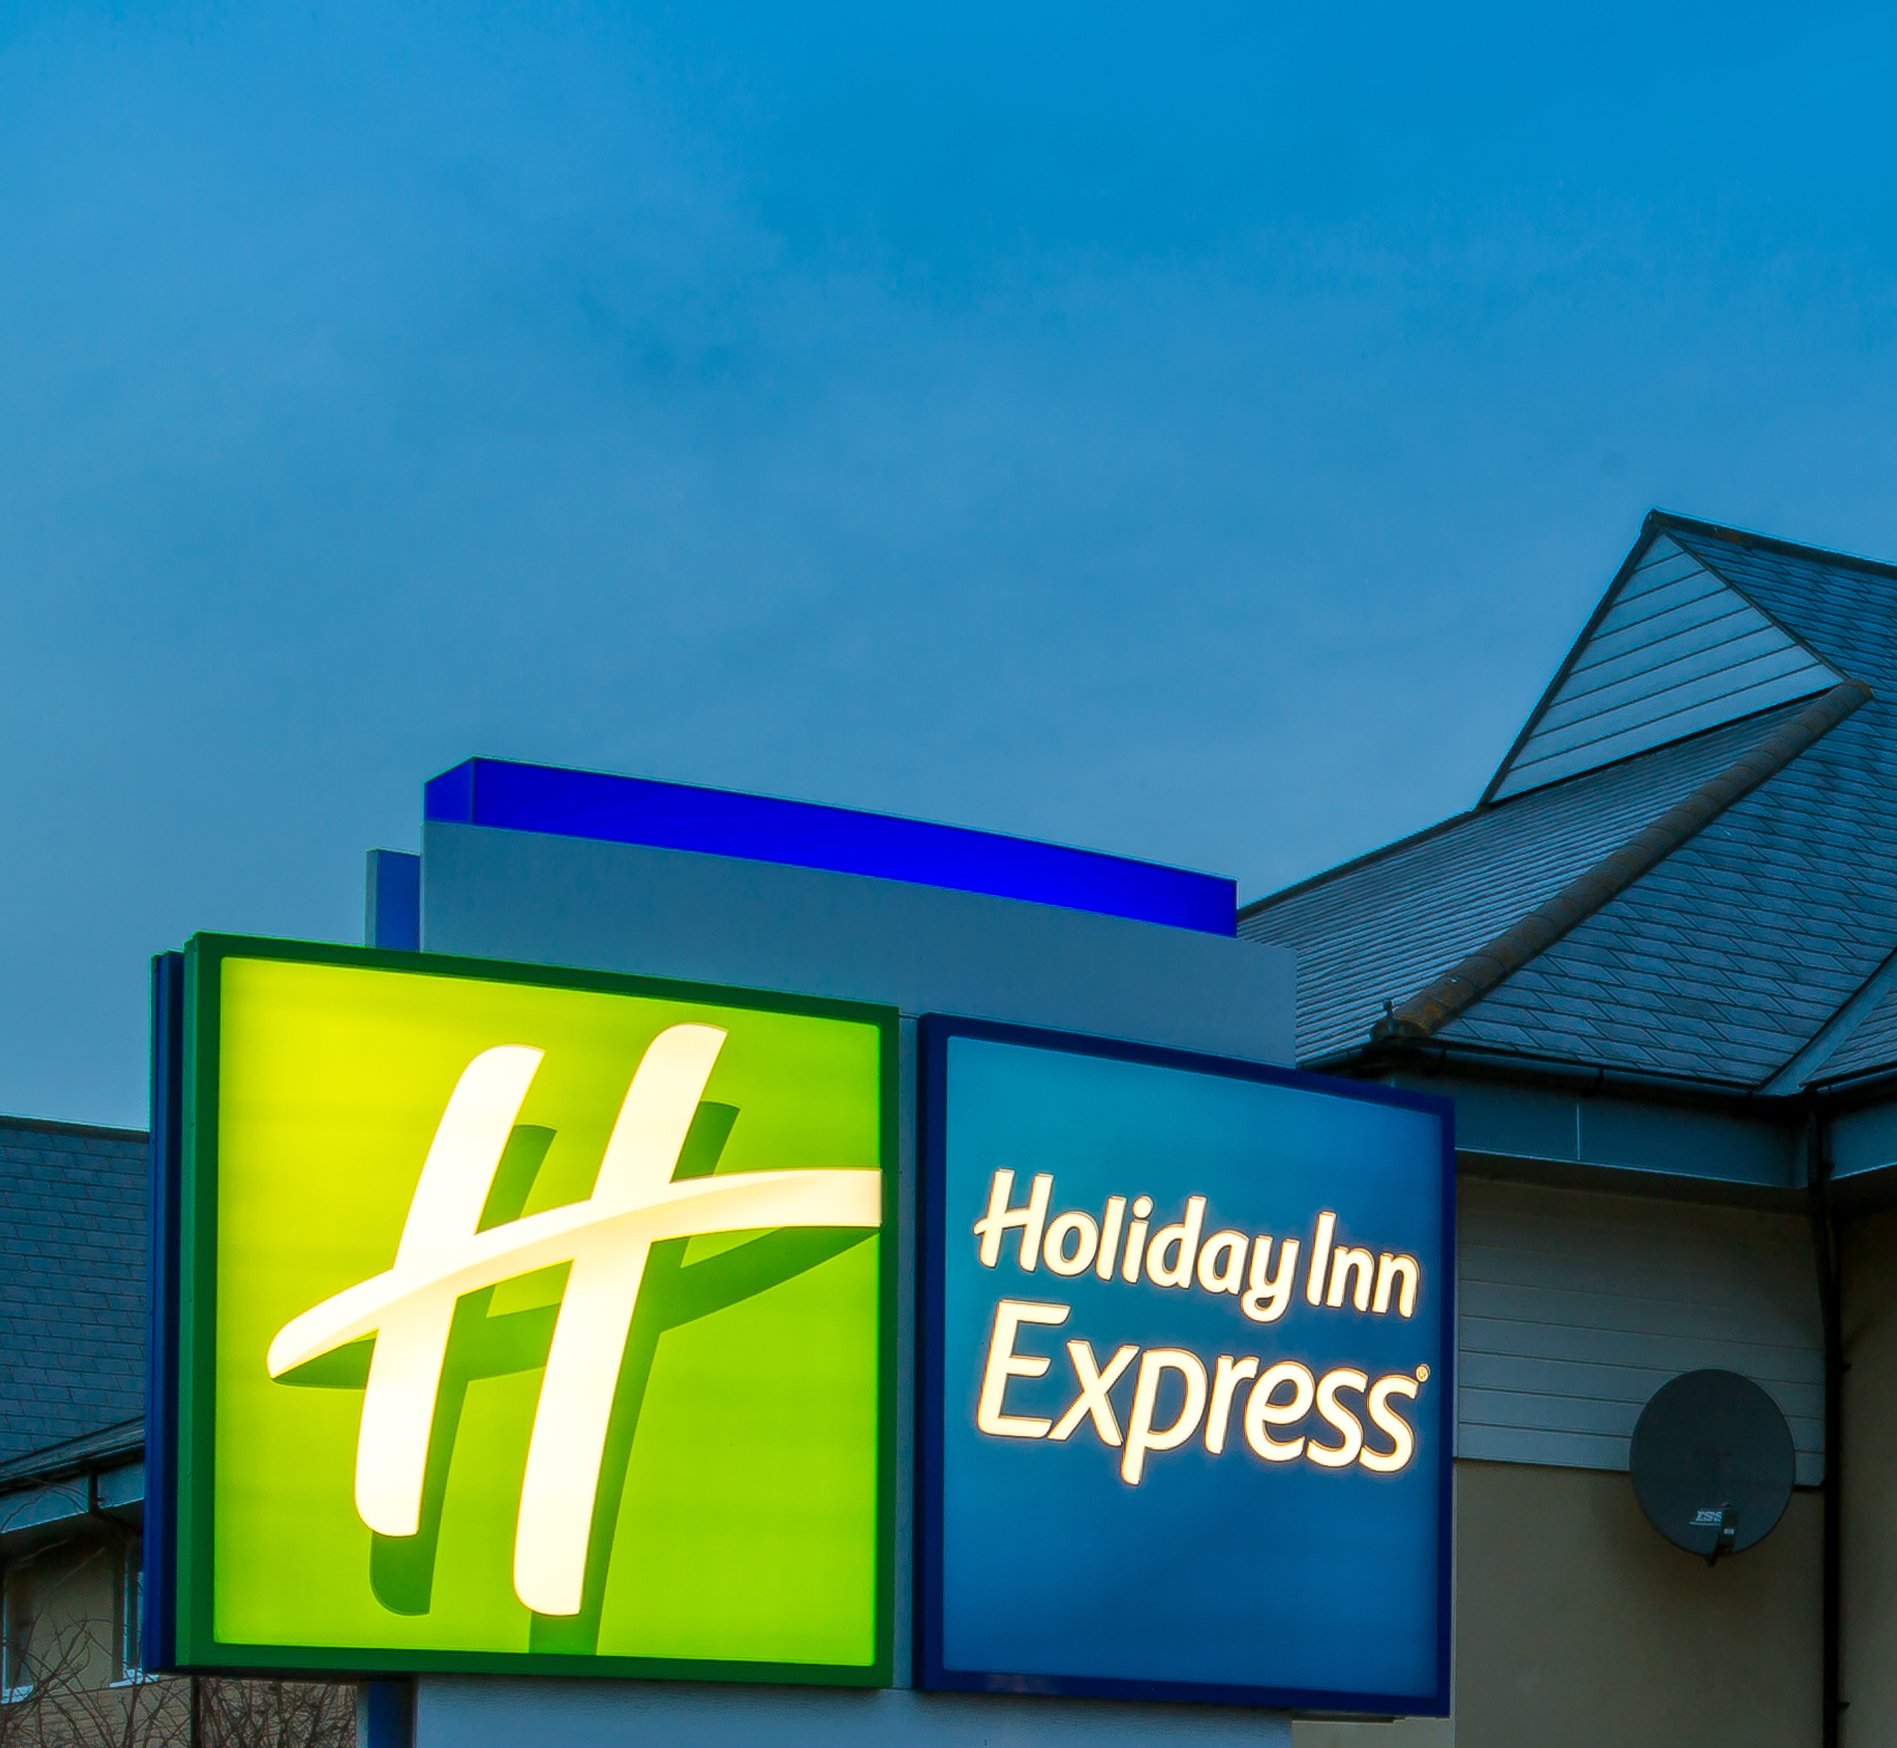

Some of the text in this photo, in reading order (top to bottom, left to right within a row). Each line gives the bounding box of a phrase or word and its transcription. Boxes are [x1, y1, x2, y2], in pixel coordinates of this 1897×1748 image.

[973, 1168, 1420, 1322] Holiday Inn
[977, 1299, 1420, 1485] Express
